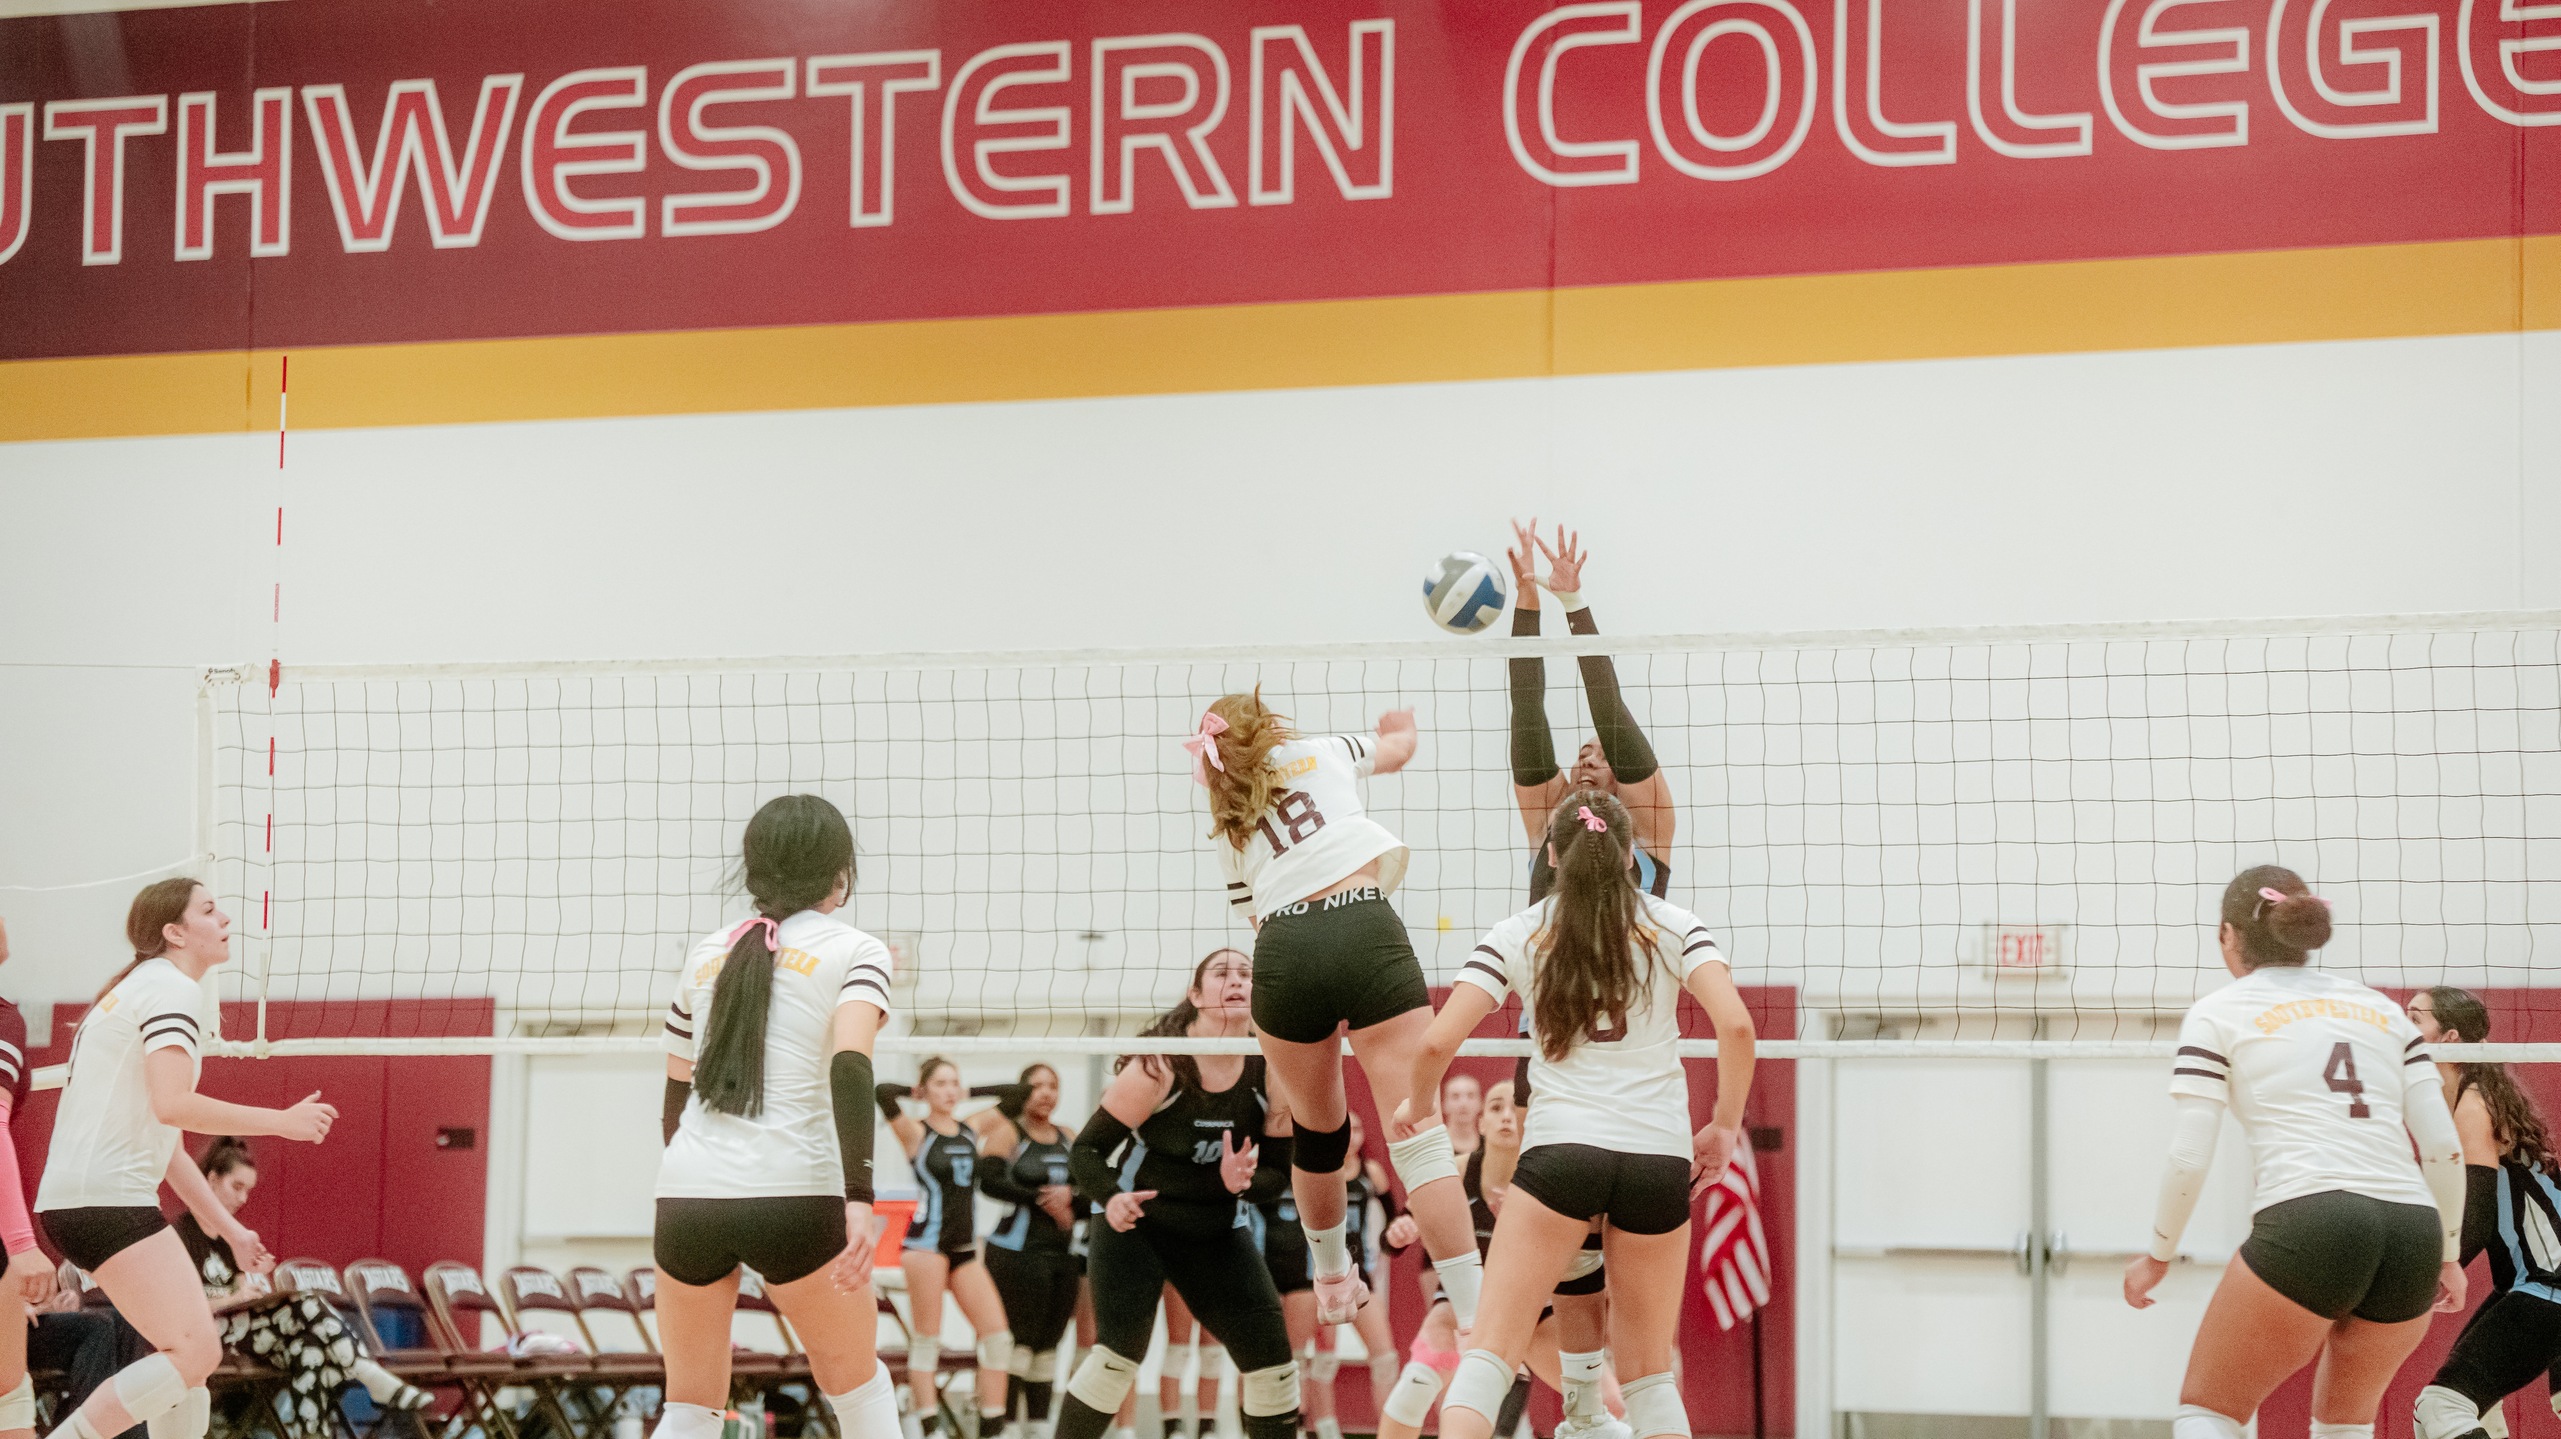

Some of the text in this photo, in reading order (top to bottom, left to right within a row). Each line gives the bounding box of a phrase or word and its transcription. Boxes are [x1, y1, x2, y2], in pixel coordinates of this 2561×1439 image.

[1255, 791, 1326, 860] 18
[1264, 900, 1310, 922] RO
[1323, 885, 1377, 911] NIKE
[2001, 932, 2045, 967] EXIT
[2322, 1041, 2371, 1119] 4
[1191, 1140, 1223, 1165] 10
